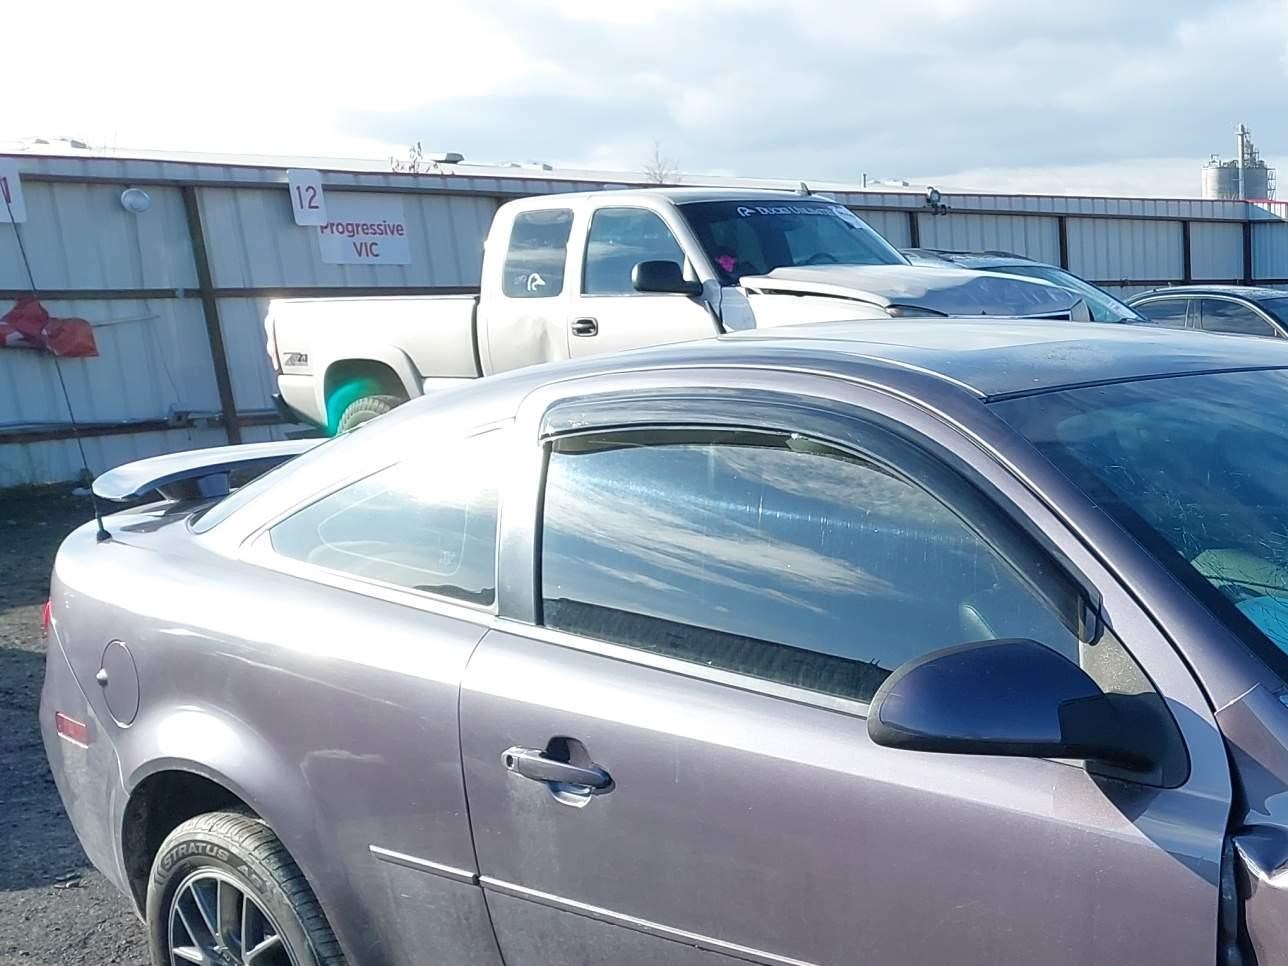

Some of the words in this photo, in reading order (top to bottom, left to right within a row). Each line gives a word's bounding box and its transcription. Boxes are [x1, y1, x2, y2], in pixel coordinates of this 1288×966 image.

[296, 185, 320, 209] 12
[320, 220, 405, 238] Progressive
[353, 242, 380, 257] VIC
[163, 842, 230, 870] STRATUS
